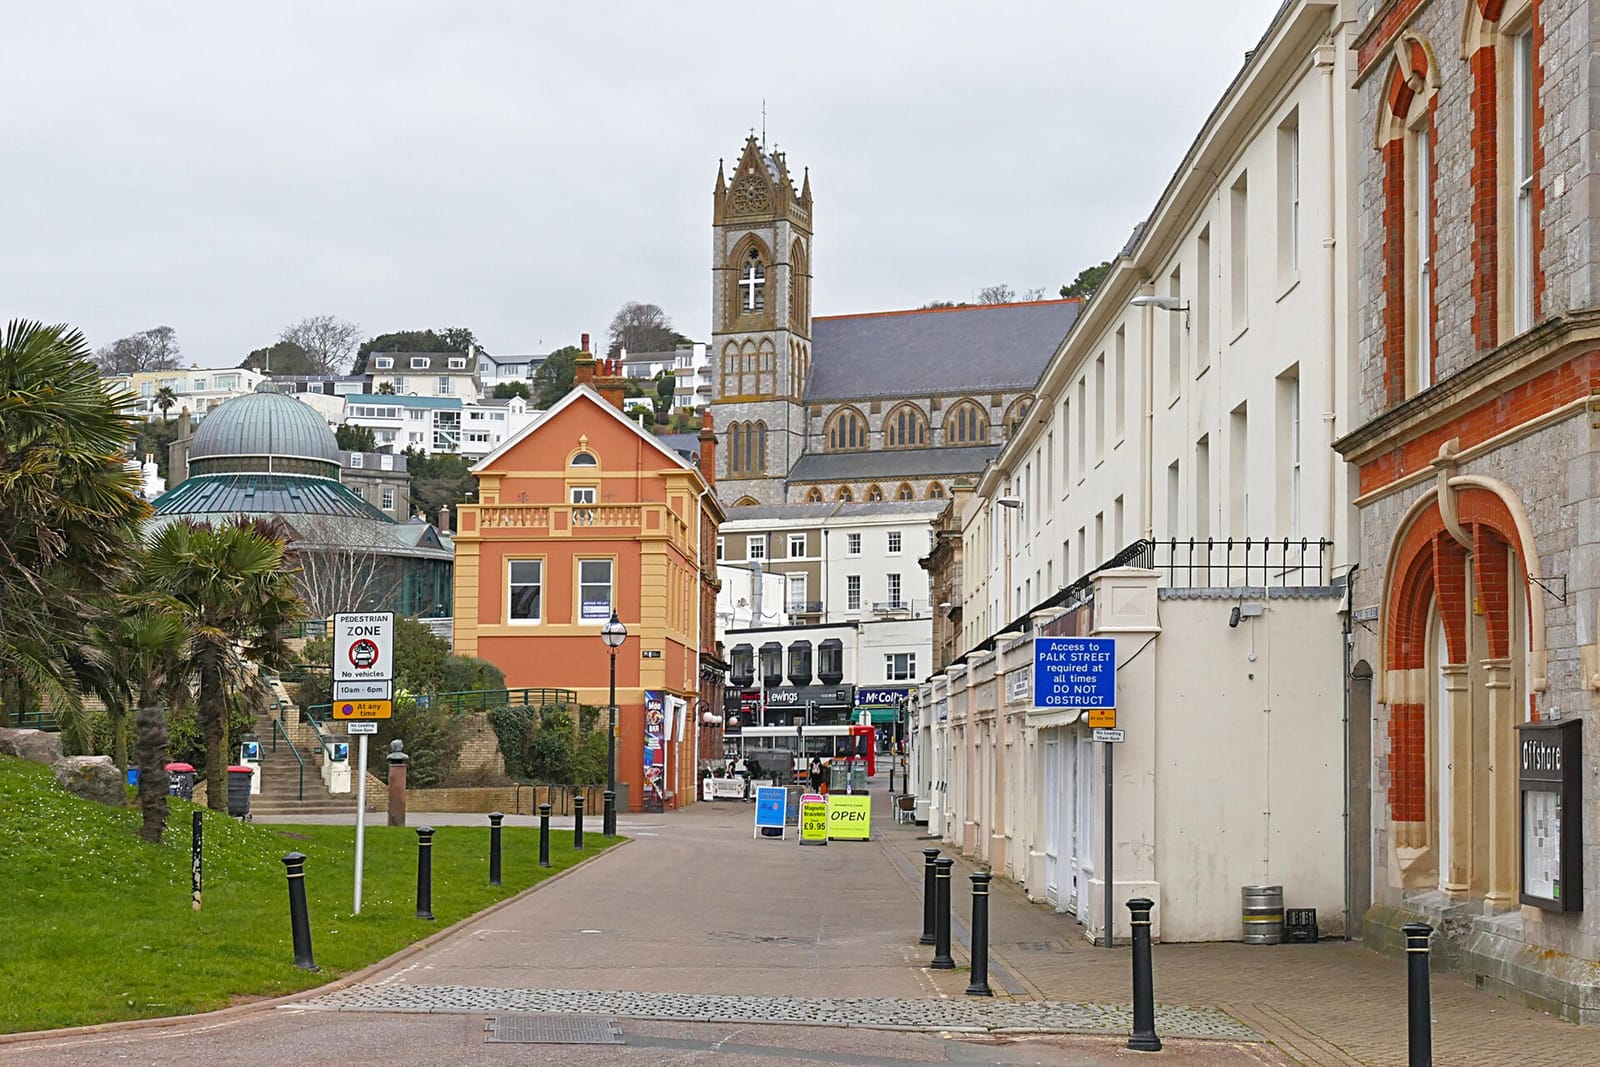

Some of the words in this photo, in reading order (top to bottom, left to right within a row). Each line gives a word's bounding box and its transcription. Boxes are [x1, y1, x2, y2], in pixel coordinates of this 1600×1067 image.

[347, 626, 381, 636] ZONE
[1051, 642, 1085, 651] Access
[1089, 642, 1100, 651] to
[1040, 652, 1066, 661] PALK
[1071, 652, 1111, 661] STREET
[1047, 663, 1088, 673] required
[1092, 664, 1103, 672] at
[1053, 674, 1066, 682] all
[1070, 674, 1097, 682] times
[1053, 685, 1070, 693] DO
[1074, 685, 1097, 693] NOT
[771, 690, 798, 704] ewings
[1046, 695, 1104, 705] OBSTRUCT
[1523, 741, 1561, 771] Offshore
[831, 811, 866, 821] OPEN
[804, 822, 826, 830] £9.95
